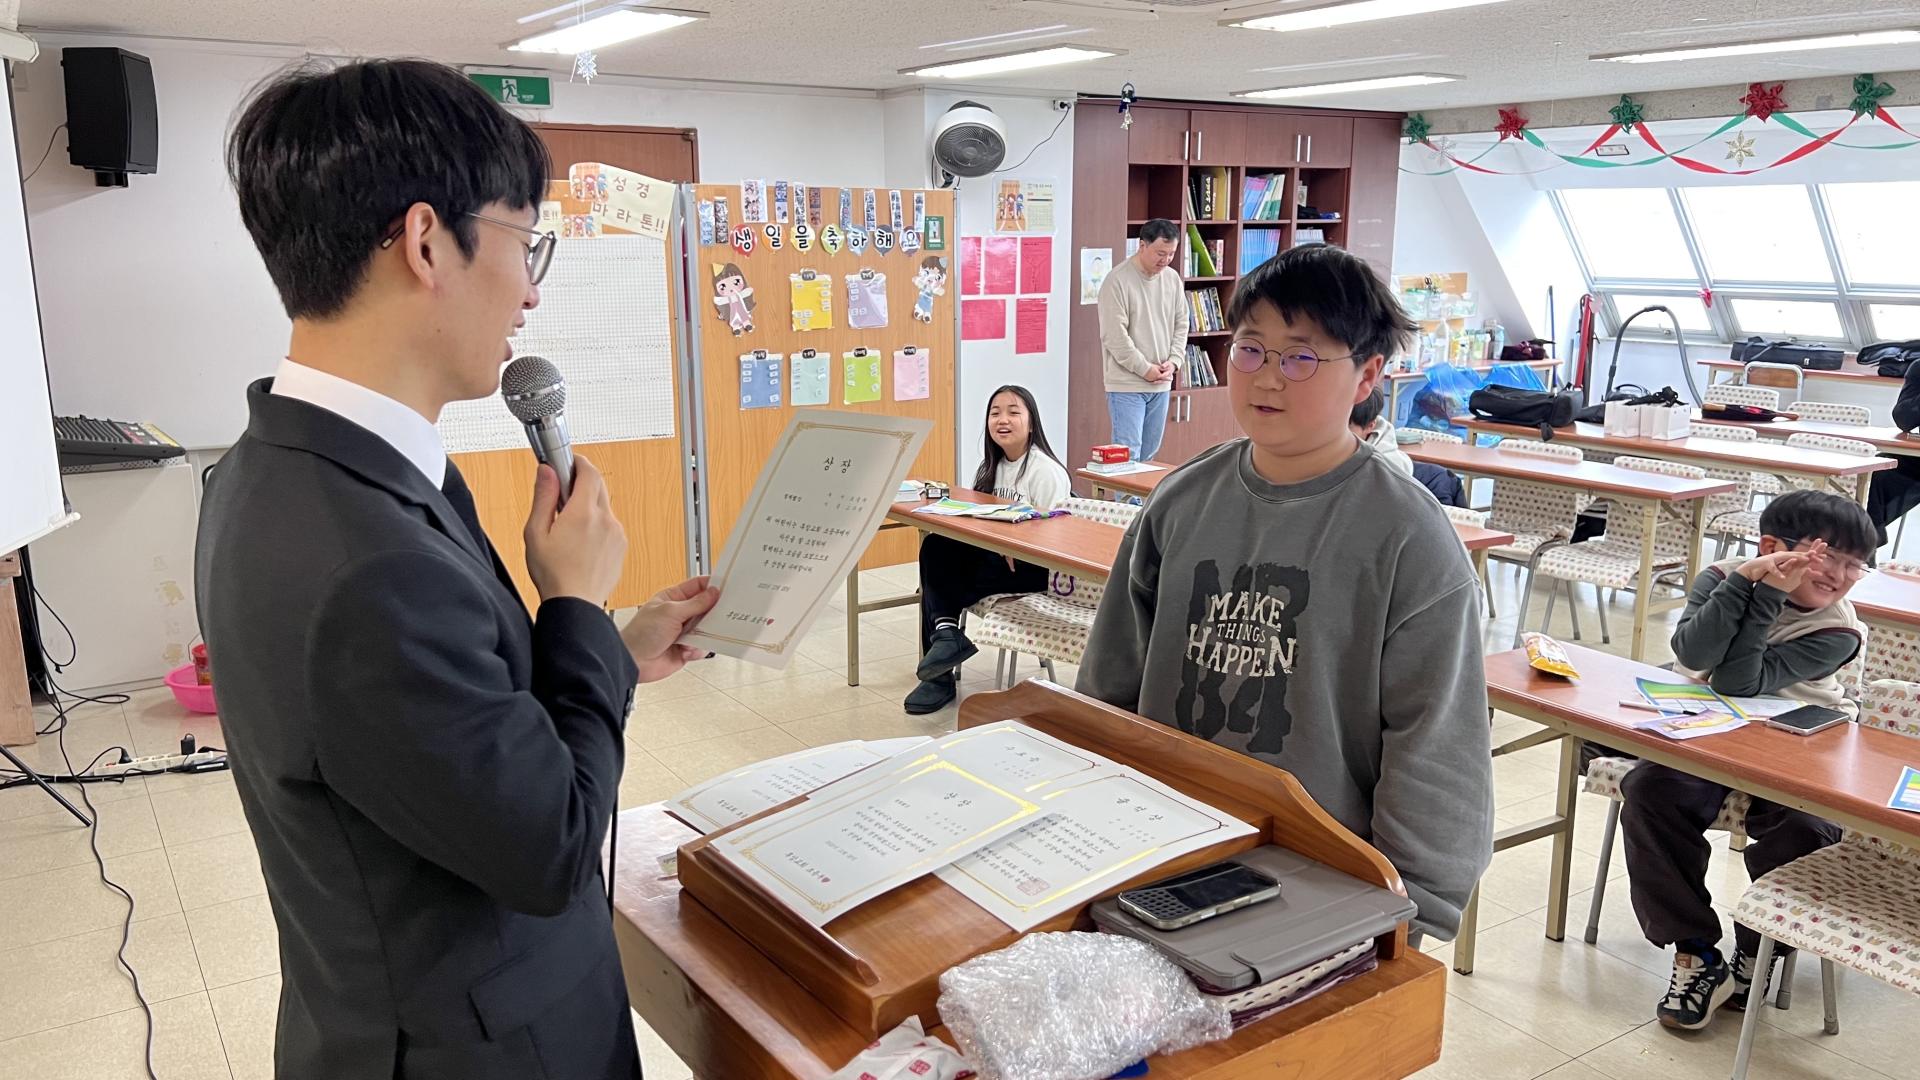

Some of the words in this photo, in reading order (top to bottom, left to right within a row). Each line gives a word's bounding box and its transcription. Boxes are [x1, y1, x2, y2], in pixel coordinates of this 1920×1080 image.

[1207, 591, 1285, 632] MAKE
[1186, 623, 1297, 677] HAPPEN
[1216, 623, 1266, 643] THINGS
